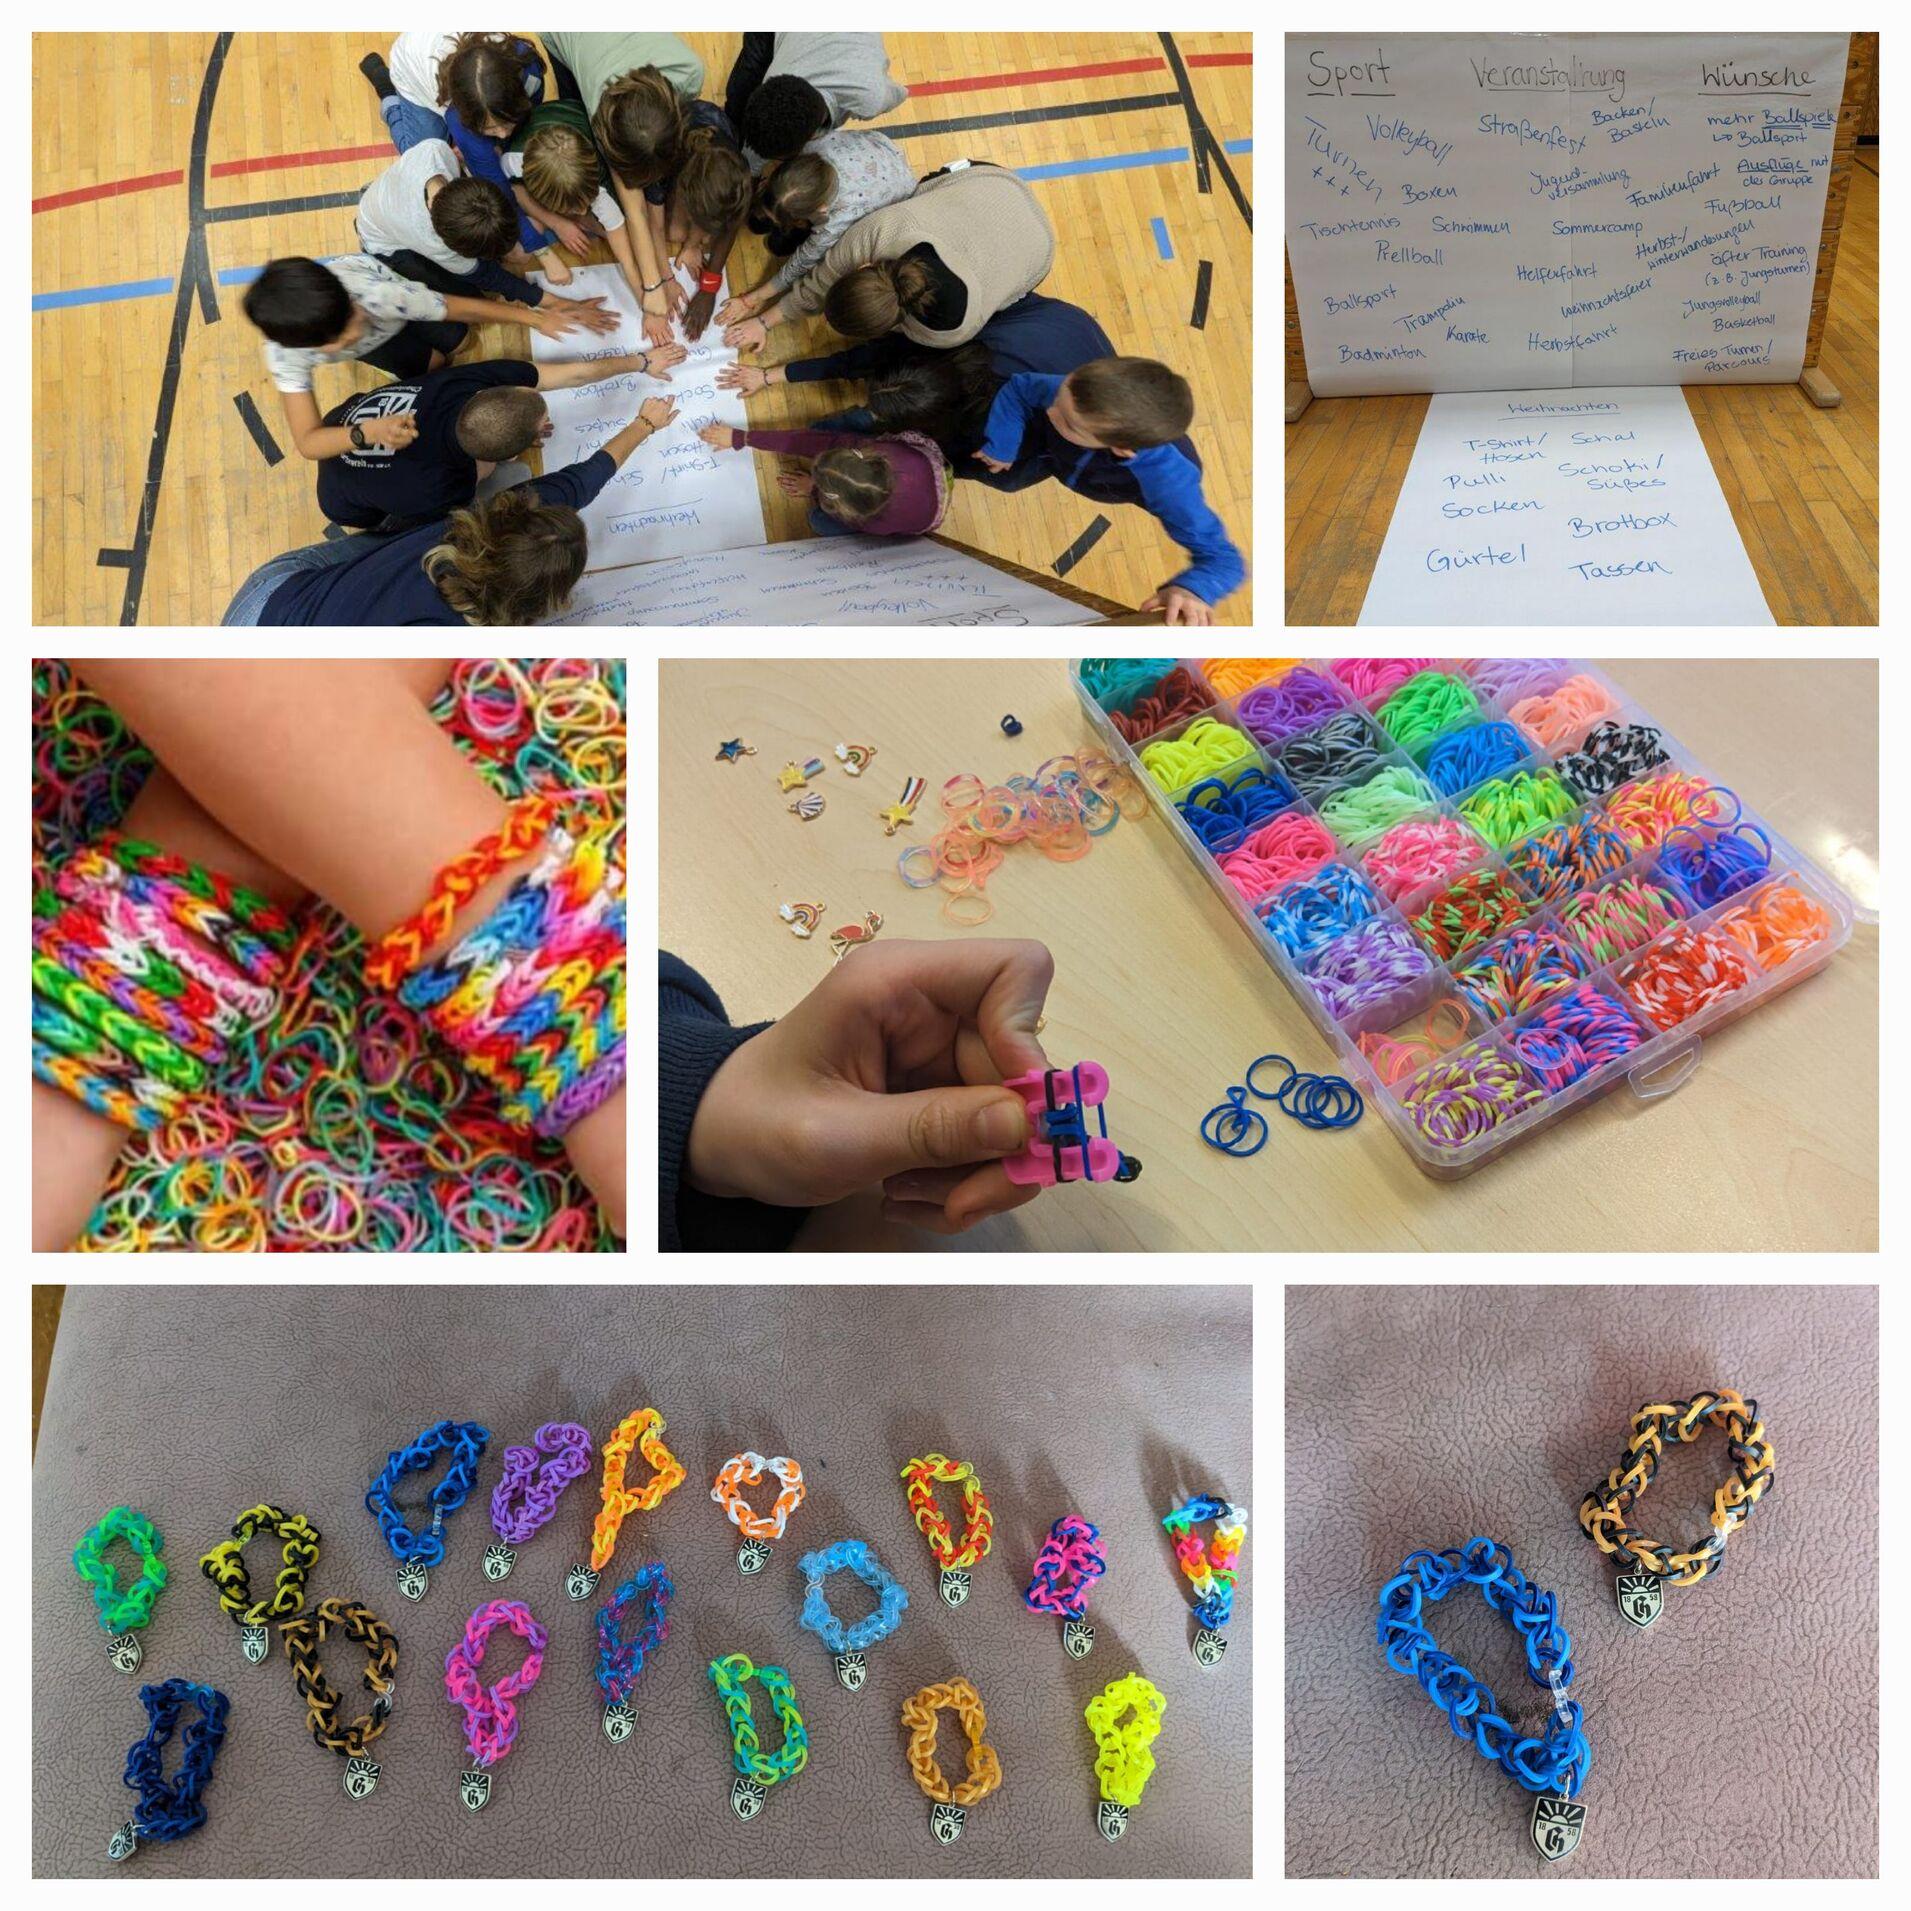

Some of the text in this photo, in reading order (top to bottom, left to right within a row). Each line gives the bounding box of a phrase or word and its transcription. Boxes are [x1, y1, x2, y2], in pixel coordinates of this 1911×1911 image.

[1307, 48, 1390, 96] Sport
[1469, 55, 1626, 103] Veranstaltung
[1702, 61, 1816, 87] Wünsche
[1607, 117, 1672, 143] Basteln
[1707, 113, 1758, 126] mehr
[1366, 114, 1453, 166] Volleyball
[1477, 113, 1586, 155] Straßenfest
[1736, 129, 1808, 148] Ballsport
[1305, 115, 1382, 202] Turnen
[1737, 155, 1829, 174] Ausflüge mit
[1626, 162, 1721, 208] Familienfahrt
[1743, 174, 1814, 188] der Gruppe
[1402, 184, 1458, 204] Boxen
[1704, 195, 1783, 217] Fußball
[1300, 213, 1401, 240] Tischtennis
[1552, 220, 1643, 237] Sommercamp
[1375, 239, 1445, 266] Prellball
[1710, 243, 1808, 267] öfter Training
[1517, 263, 1598, 284] Helferfahrt
[1323, 283, 1398, 315] Ballsport
[1682, 290, 1761, 319] Jungsvolleyball
[1392, 296, 1466, 333] Trampolin
[1712, 314, 1775, 332] Basketball
[1446, 326, 1489, 344] Karate
[1528, 324, 1617, 351] Herbstfahrt
[1338, 344, 1427, 363] Badminton
[1672, 348, 1718, 363] Freies
[1704, 355, 1770, 373] Parcours
[1507, 400, 1620, 414] Weihnachten
[1571, 430, 1636, 446] Schal
[1480, 450, 1548, 465] Hosen
[1443, 471, 1506, 490] Pulli
[1586, 477, 1666, 493] Süßes
[1442, 498, 1545, 519] Socken
[608, 509, 701, 535] Weihnachten
[1567, 512, 1678, 539] Brotbox
[1426, 543, 1526, 573] Gürtel
[1568, 558, 1673, 581] Tassen
[1623, 1595, 1631, 1603] 18
[1538, 1821, 1577, 1836] 18 58
